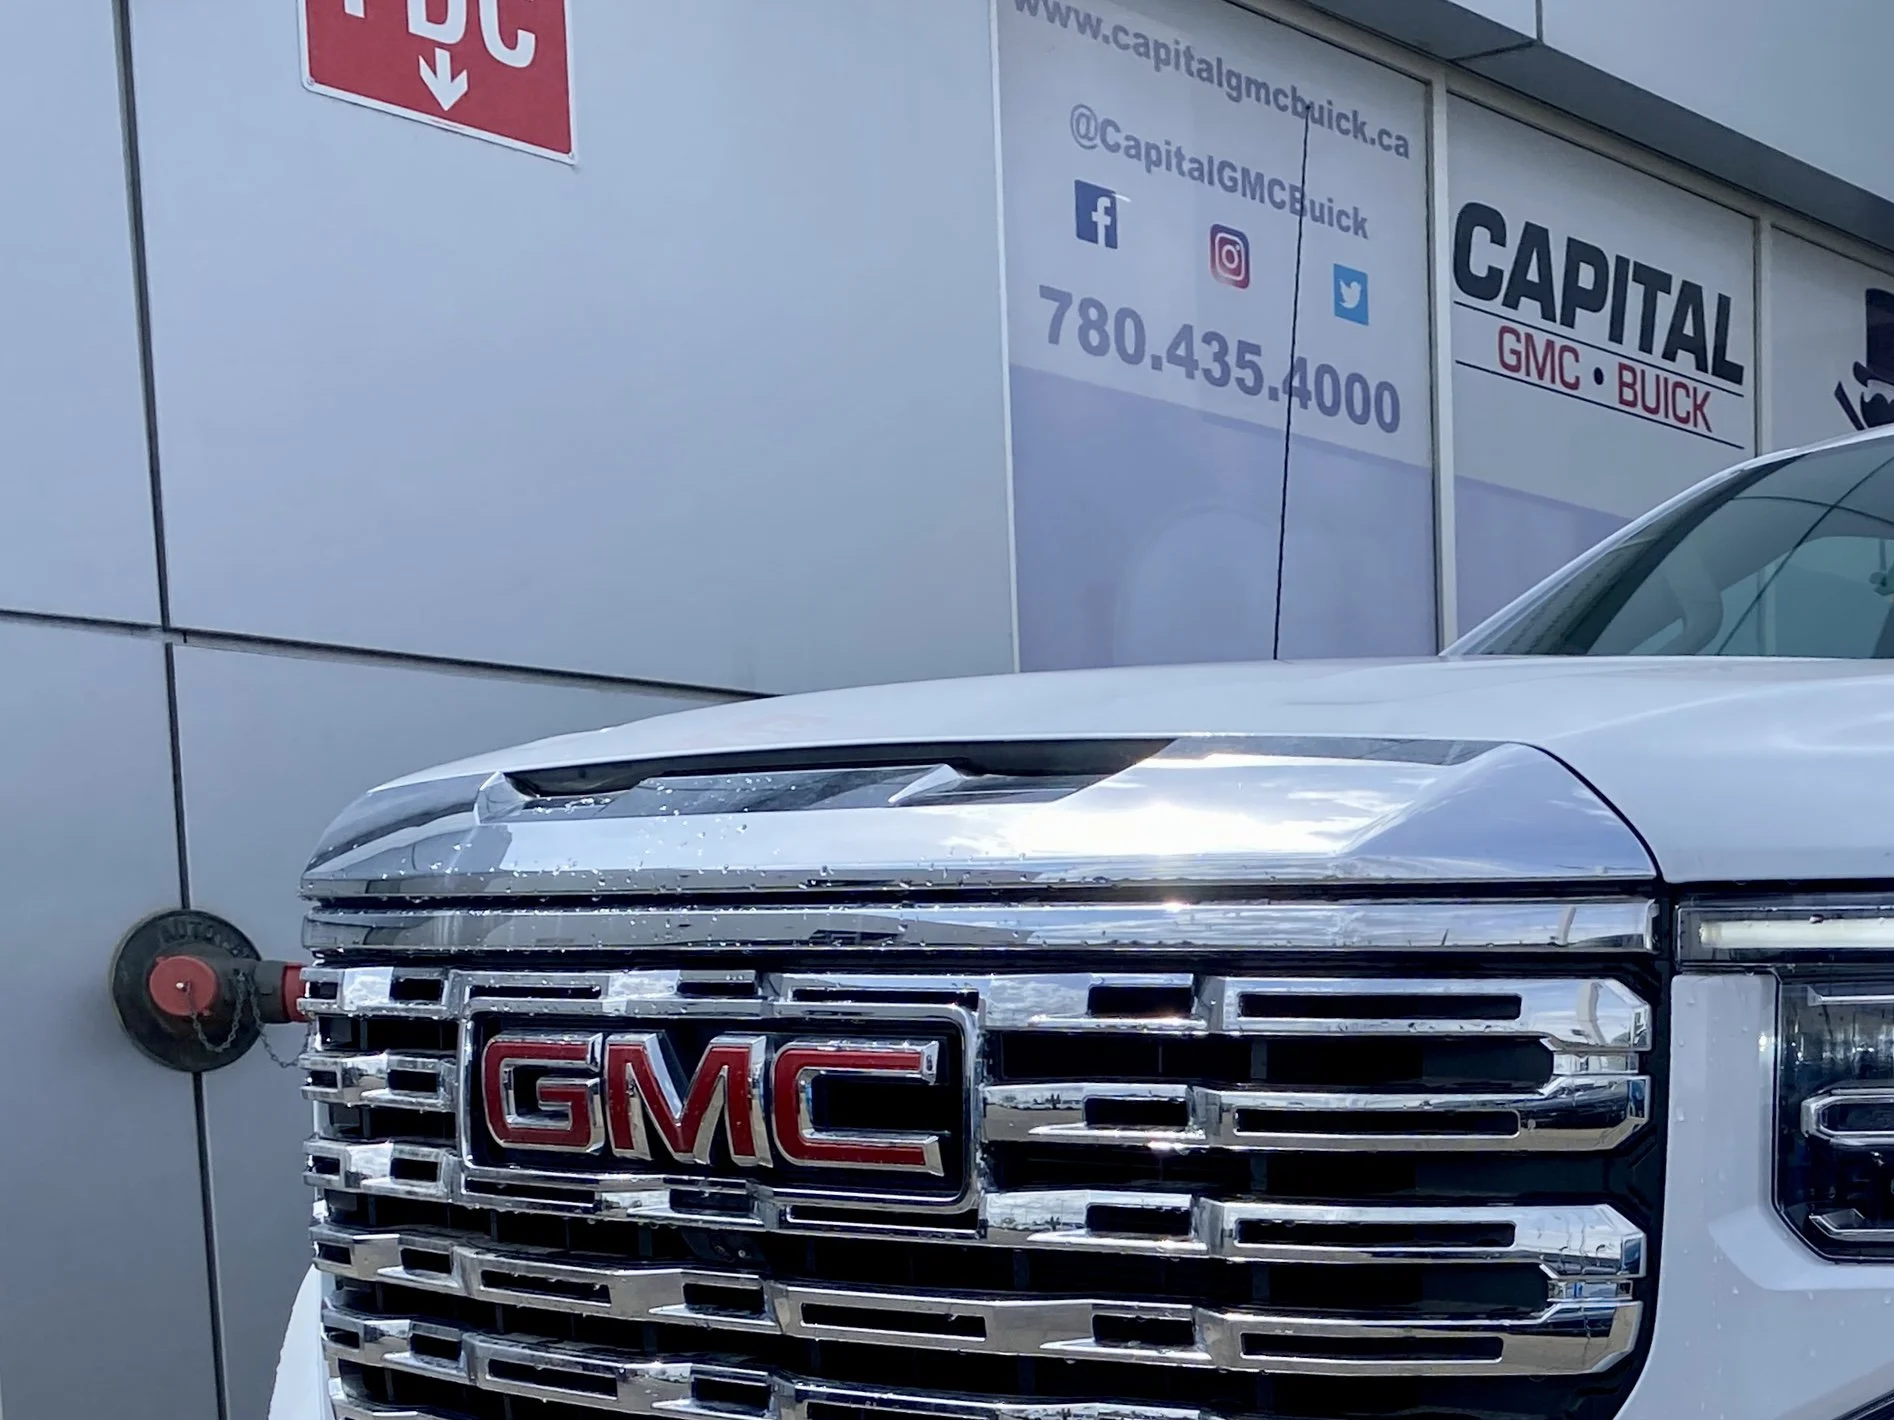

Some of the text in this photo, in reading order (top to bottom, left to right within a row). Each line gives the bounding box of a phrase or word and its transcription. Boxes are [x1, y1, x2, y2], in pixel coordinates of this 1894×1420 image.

[343, 0, 536, 68] DC
[1012, 0, 1411, 160] www.capitalgmcbuick.ca
[1069, 104, 1370, 239] @CapitalGMCBuick
[1038, 284, 1400, 434] 780.435.4000
[1453, 201, 1745, 386] CAPITAL
[1497, 325, 1713, 433] GMC BUICK
[481, 1030, 946, 1177] GMC
